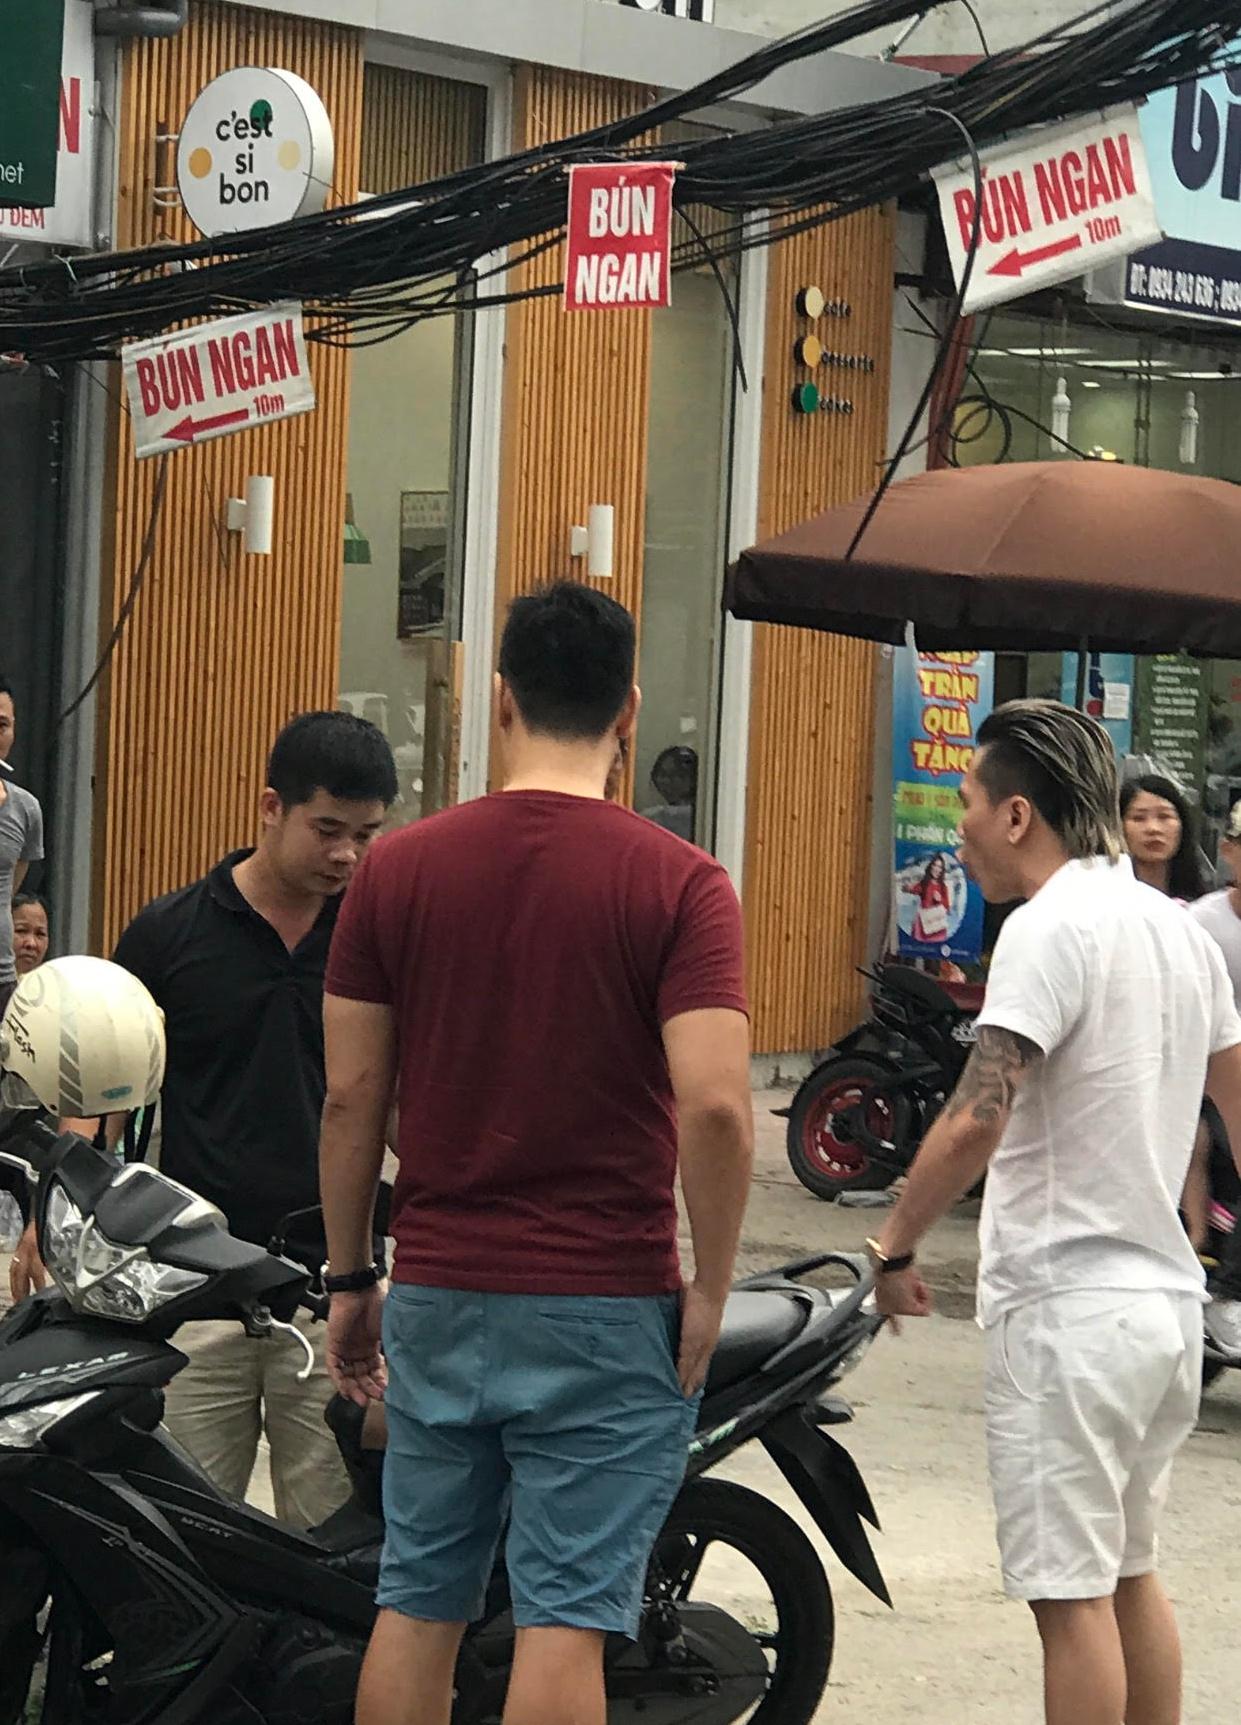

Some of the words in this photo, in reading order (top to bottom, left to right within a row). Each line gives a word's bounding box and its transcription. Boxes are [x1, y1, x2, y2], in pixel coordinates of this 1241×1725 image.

[216, 109, 273, 141] c'est
[235, 142, 254, 174] si
[219, 172, 269, 205] bon
[953, 166, 1032, 253] BÚN
[1033, 133, 1137, 226] NGAN
[588, 175, 656, 238] BÚN
[1085, 215, 1122, 244] 10m
[574, 252, 661, 304] NGAN
[135, 341, 205, 417] BÚN
[207, 319, 301, 397] NGAN
[253, 394, 285, 418] 10m
